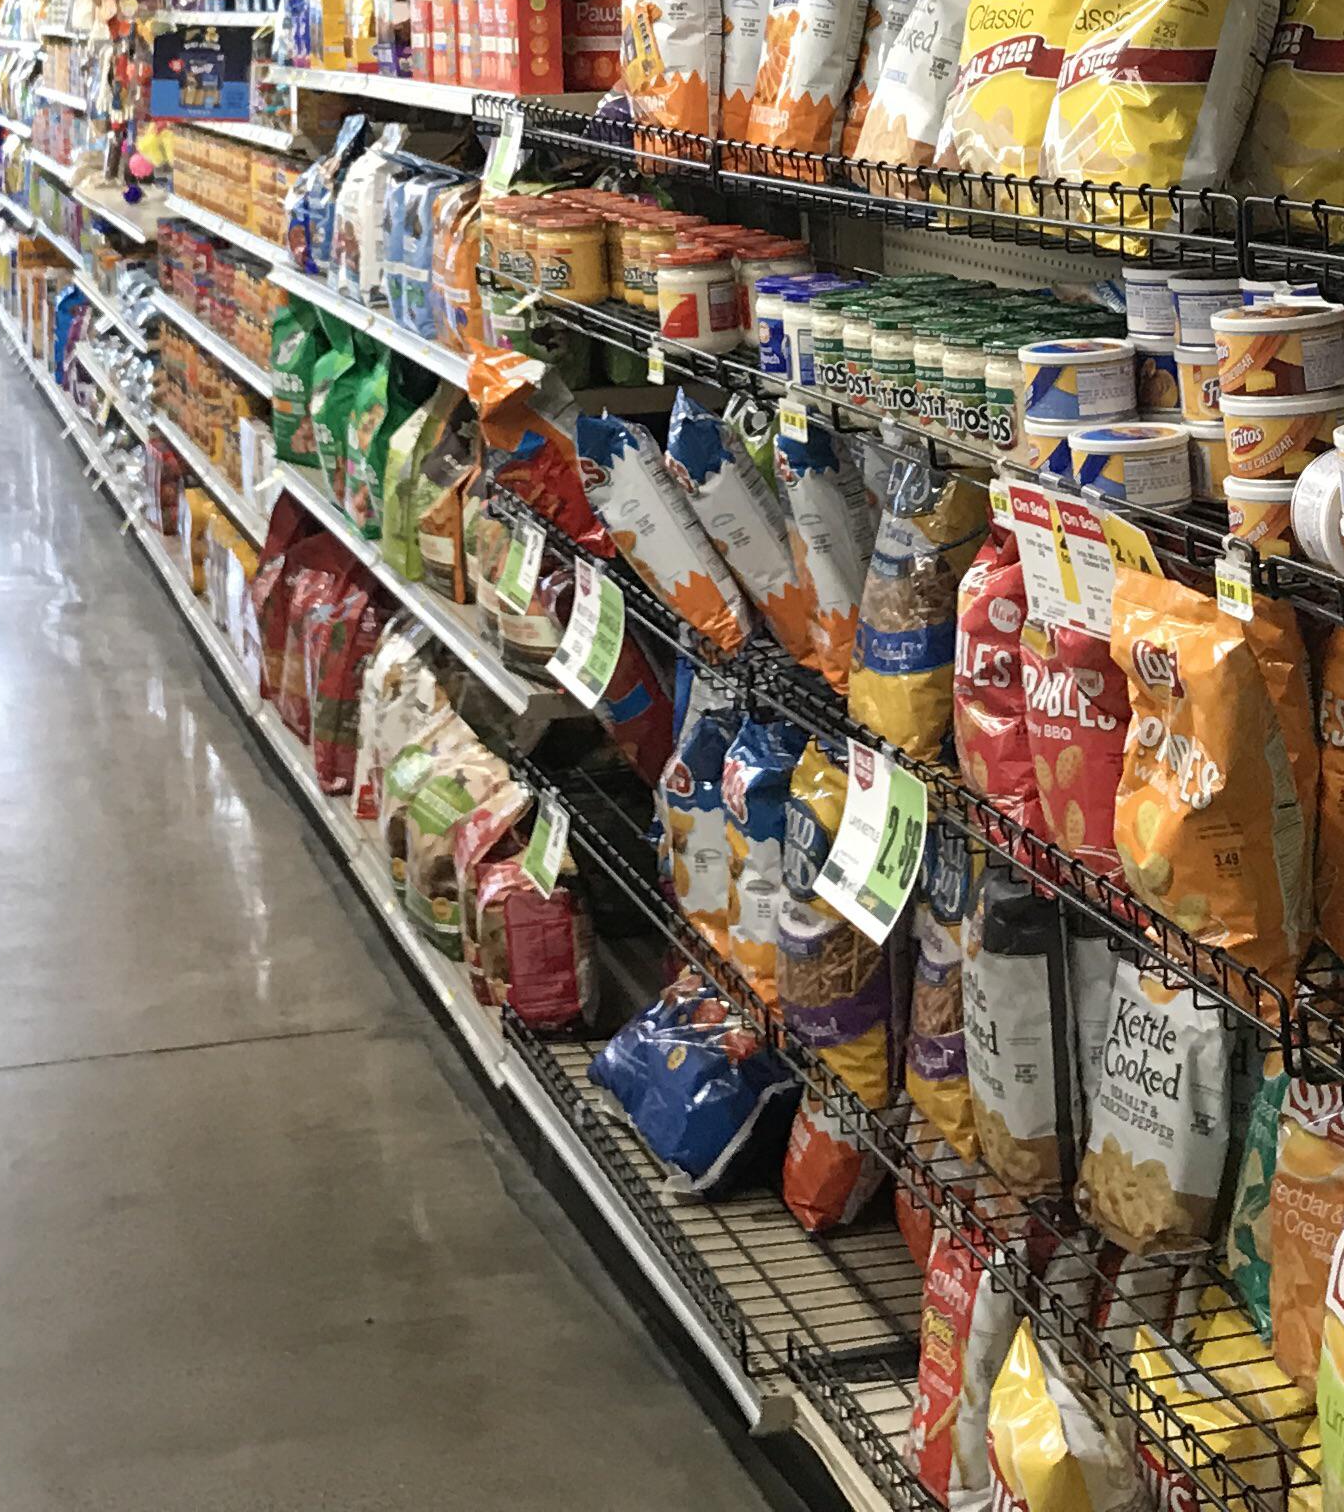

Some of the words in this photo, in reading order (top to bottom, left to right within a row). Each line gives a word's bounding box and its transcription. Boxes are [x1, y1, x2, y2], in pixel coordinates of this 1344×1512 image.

[968, 3, 1034, 34] Classic
[1231, 426, 1265, 448] Fritos
[1253, 435, 1295, 470] CHEDDAR
[1043, 724, 1073, 741] BBQ
[1113, 995, 1179, 1056] Kettle
[1104, 1040, 1184, 1102] Cooked
[1270, 1181, 1332, 1223] eddar
